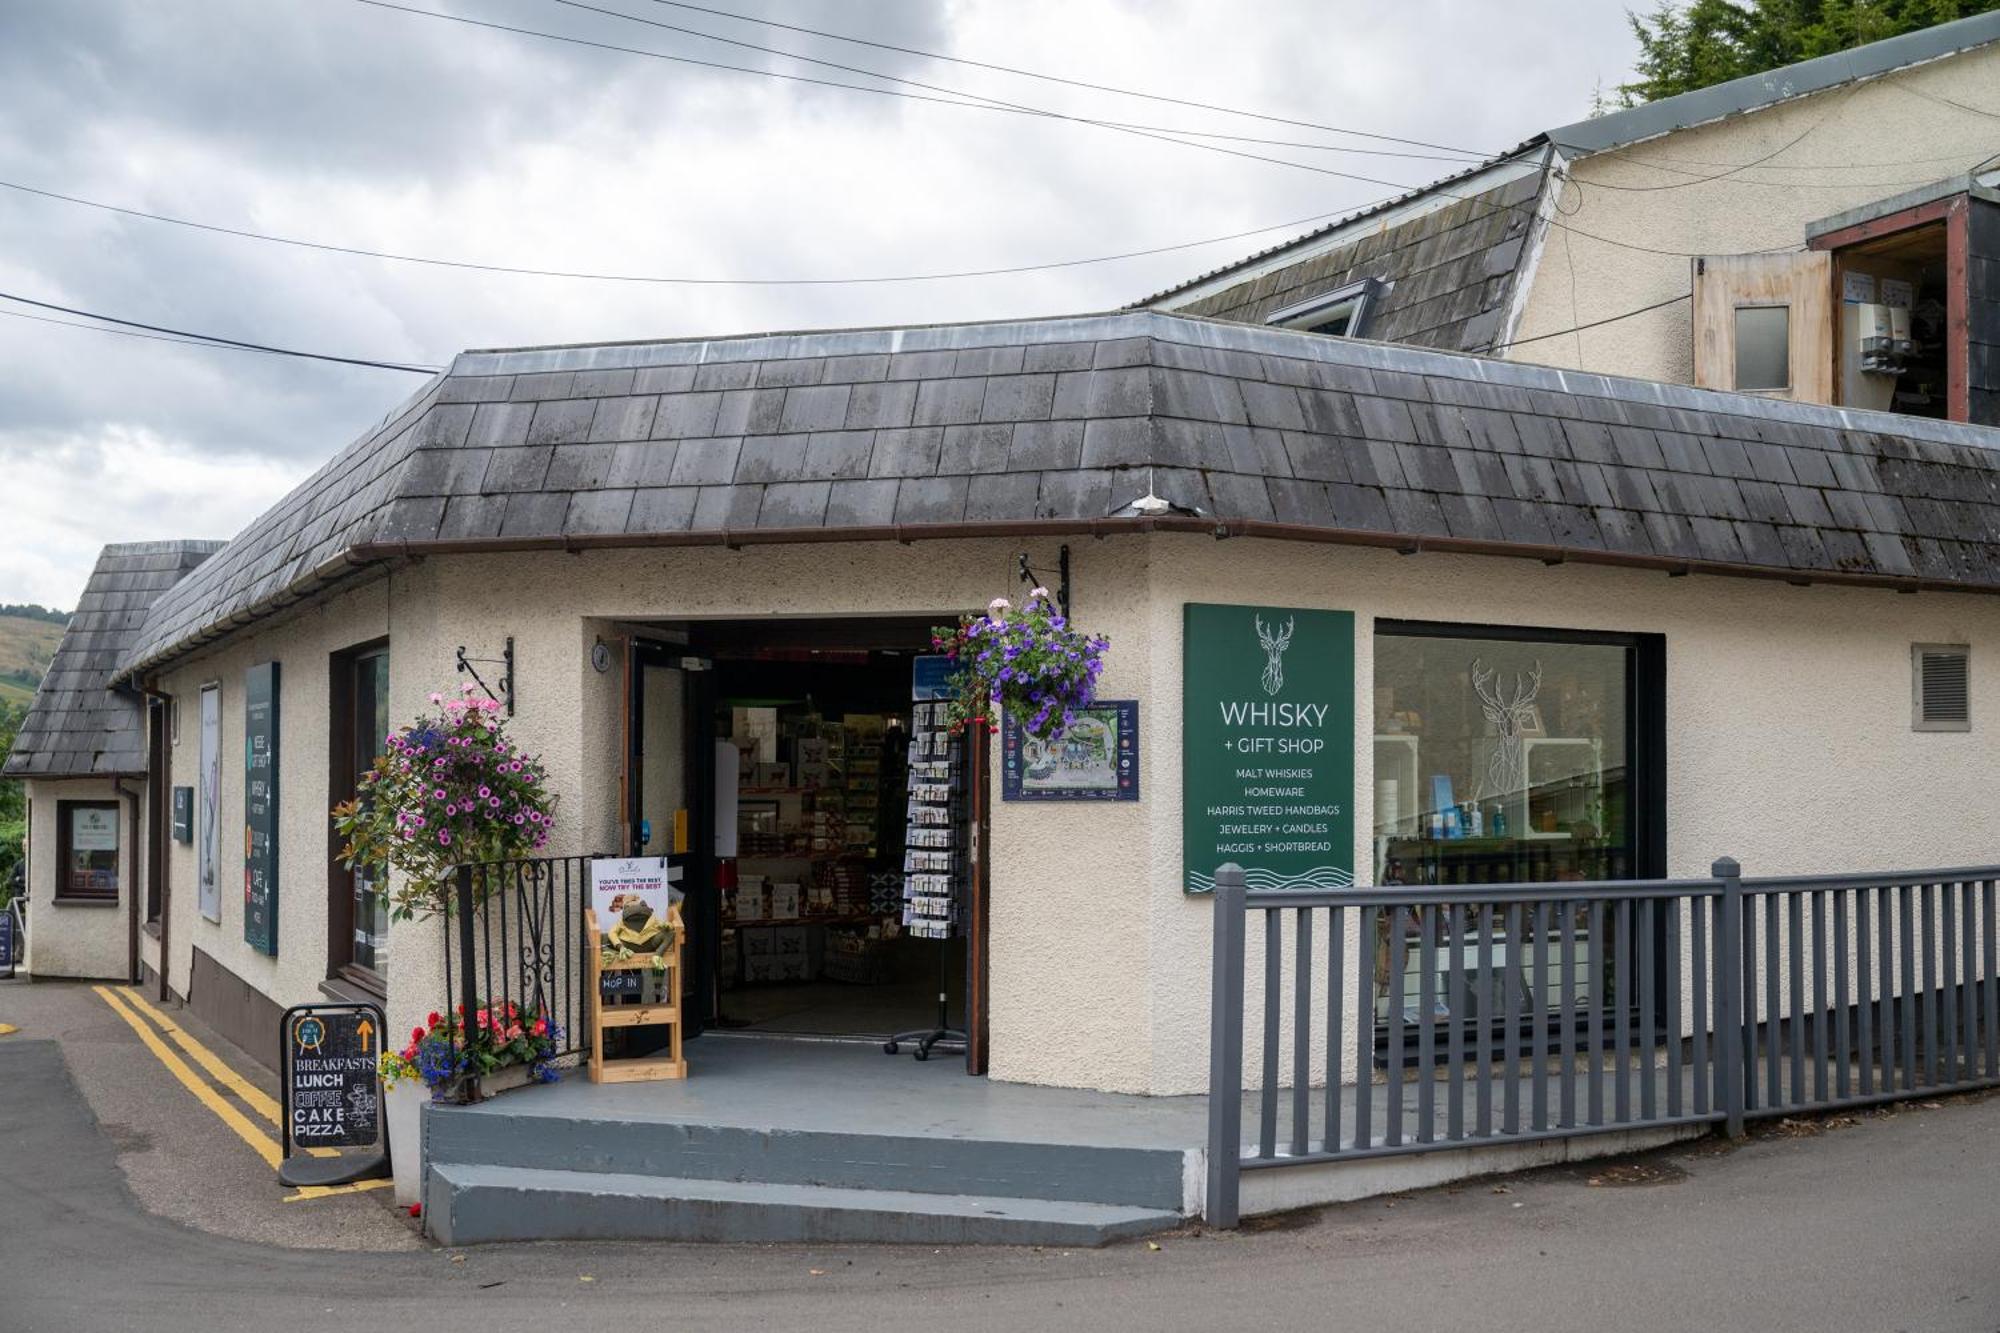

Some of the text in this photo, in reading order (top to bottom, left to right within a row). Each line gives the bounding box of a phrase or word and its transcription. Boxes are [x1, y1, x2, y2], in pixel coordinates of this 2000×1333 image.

[1220, 702, 1328, 727] WHISKY
[1238, 738, 1275, 753] GIFT
[1278, 739, 1323, 753] SHOP
[1236, 769, 1312, 778] MALT WHISKIES
[1245, 788, 1304, 797] HOMEWARE
[1207, 806, 1339, 815] HARRIS TWEED HANDBAGS
[1220, 824, 1273, 834] JEWELERY
[1283, 824, 1328, 833] CANDLES
[1217, 843, 1254, 852] HAGGIS
[1265, 842, 1331, 852] SHORTBREAD
[627, 978, 637, 987] IN
[296, 1057, 375, 1071] BREAKFASTS
[296, 1074, 343, 1087] LUNCH
[295, 1090, 342, 1107] COFFEE
[295, 1108, 344, 1122] CAKE
[295, 1124, 345, 1136] PIZZA
